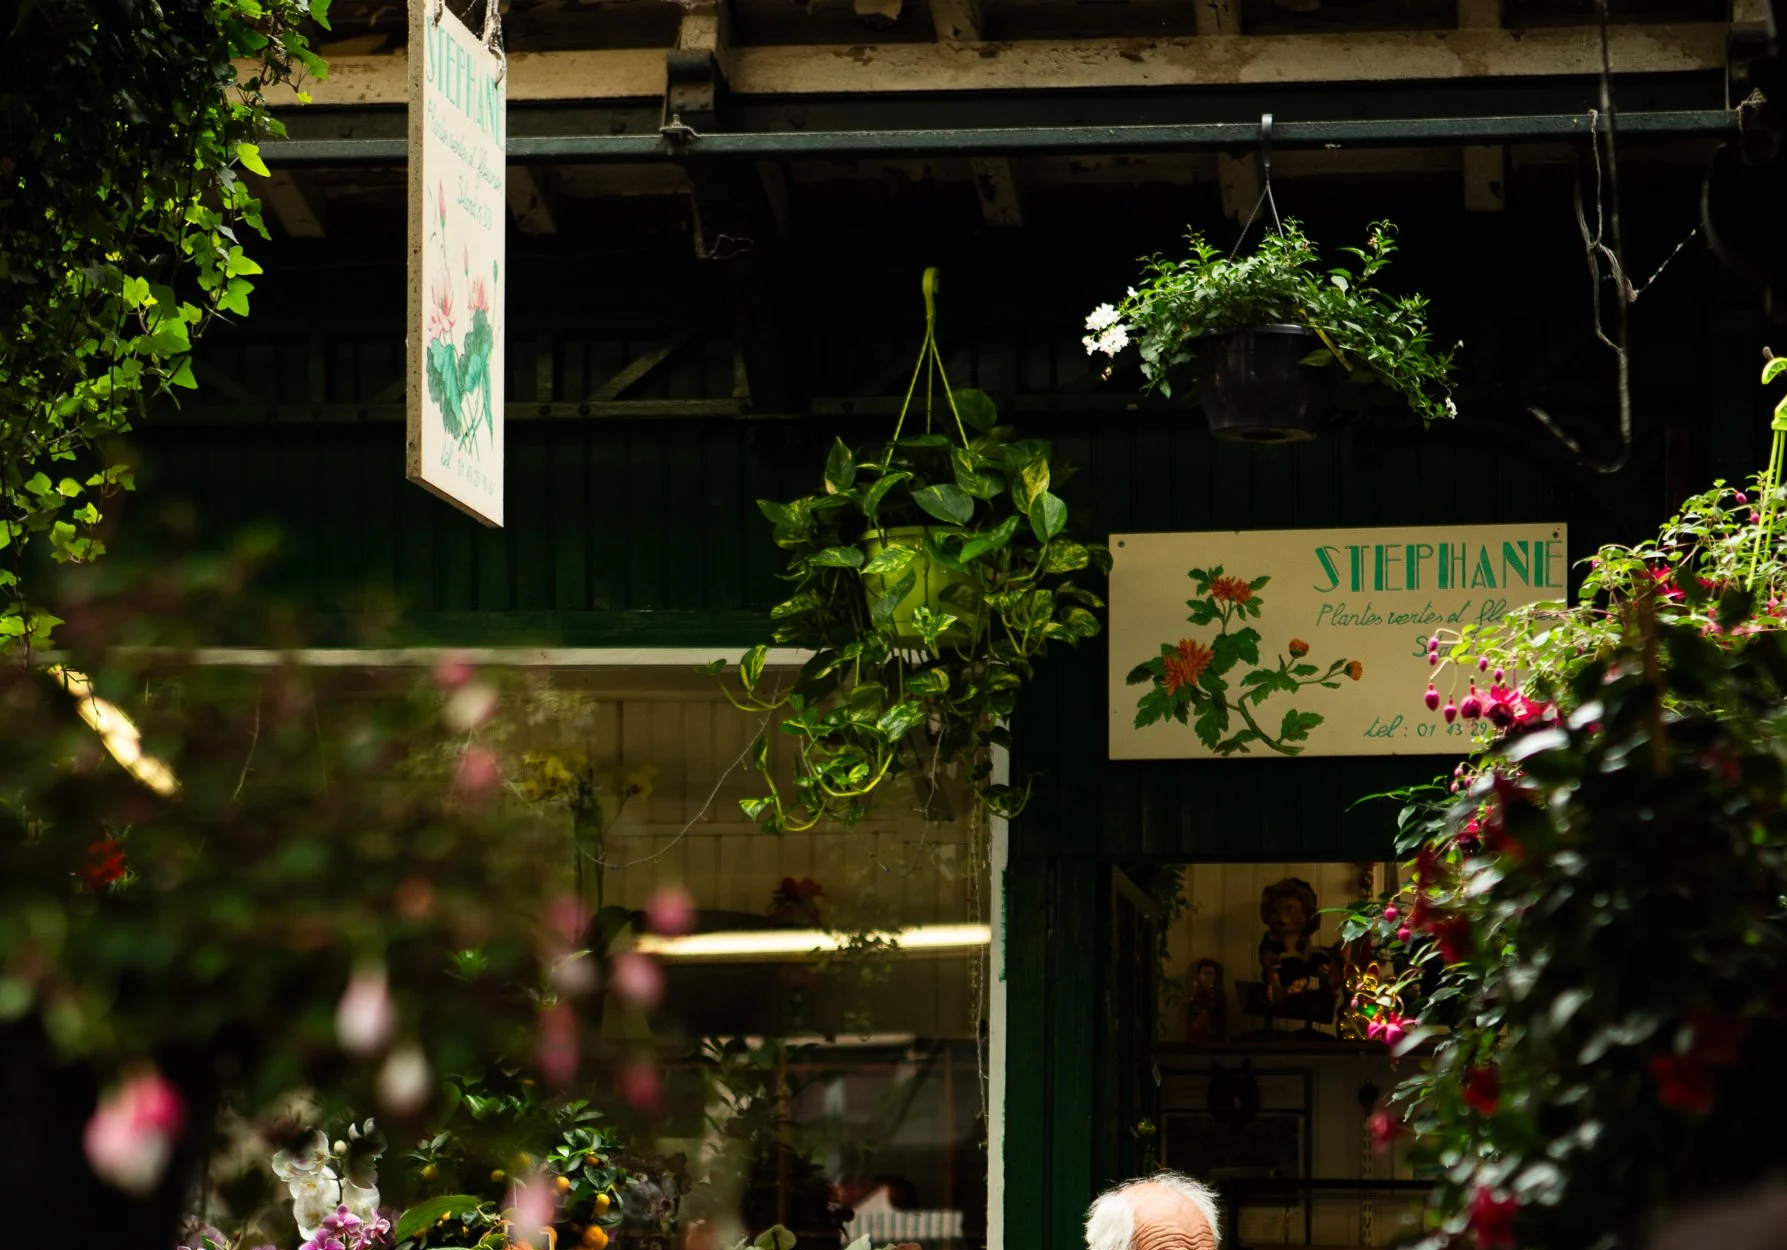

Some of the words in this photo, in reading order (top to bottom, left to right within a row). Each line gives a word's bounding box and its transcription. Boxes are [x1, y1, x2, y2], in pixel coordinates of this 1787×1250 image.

[426, 16, 504, 151] STEPHANE
[1313, 540, 1563, 593] STEPHANE
[1316, 602, 1382, 627] Plantes
[1387, 601, 1443, 625] vertes
[1446, 600, 1471, 624] et
[1417, 723, 1436, 737] 01
[1446, 723, 1462, 736] 43
[1470, 722, 1487, 736] 29
